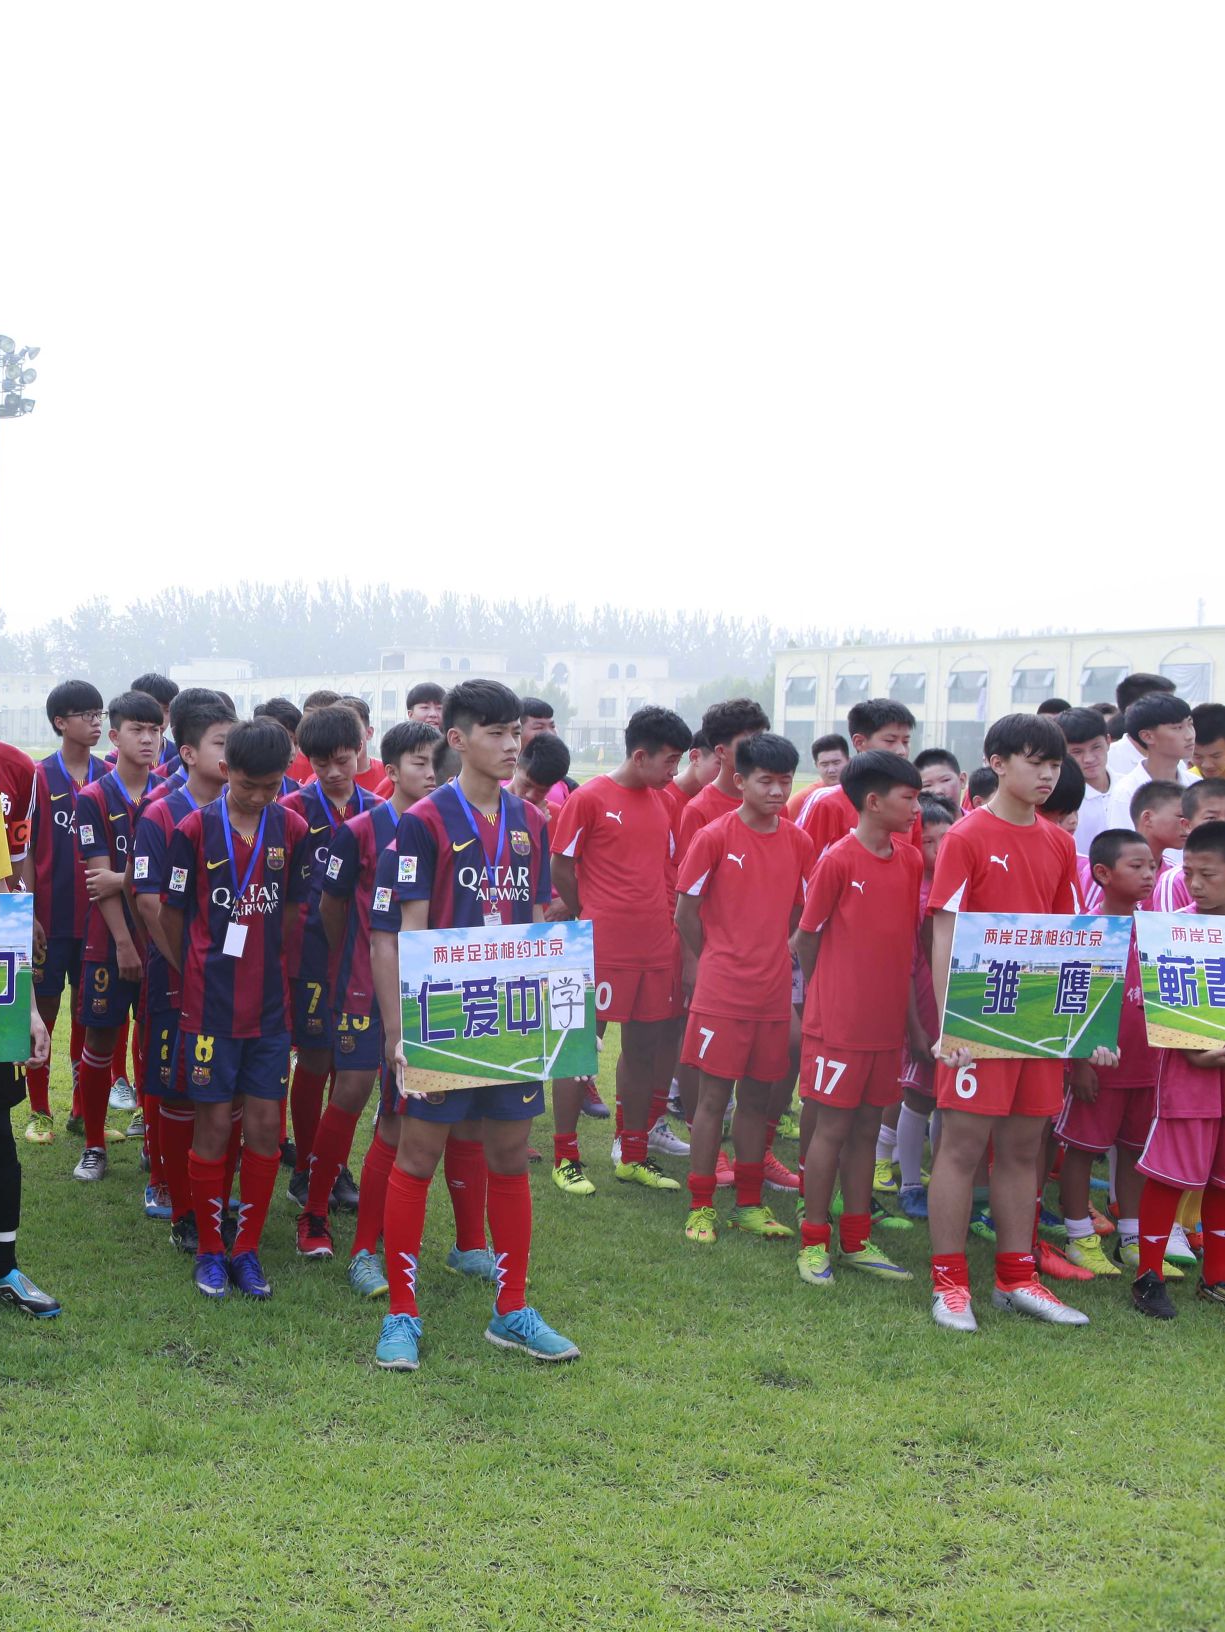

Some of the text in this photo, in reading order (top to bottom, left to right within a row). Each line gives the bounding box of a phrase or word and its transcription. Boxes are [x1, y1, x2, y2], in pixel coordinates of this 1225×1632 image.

[14, 824, 28, 842] C
[458, 866, 530, 892] QATAR
[476, 887, 530, 902] AIWAYS
[433, 938, 564, 965] 两岸足球相约北京
[984, 928, 1104, 947] 两岸足球相约北京
[94, 967, 109, 993] 9
[982, 959, 1093, 1015] 雏鹰
[307, 982, 322, 1014] 7
[417, 975, 585, 1044] 仁爱中学
[698, 1026, 715, 1060] 7
[813, 1055, 847, 1095] 17
[954, 1062, 978, 1099] 6
